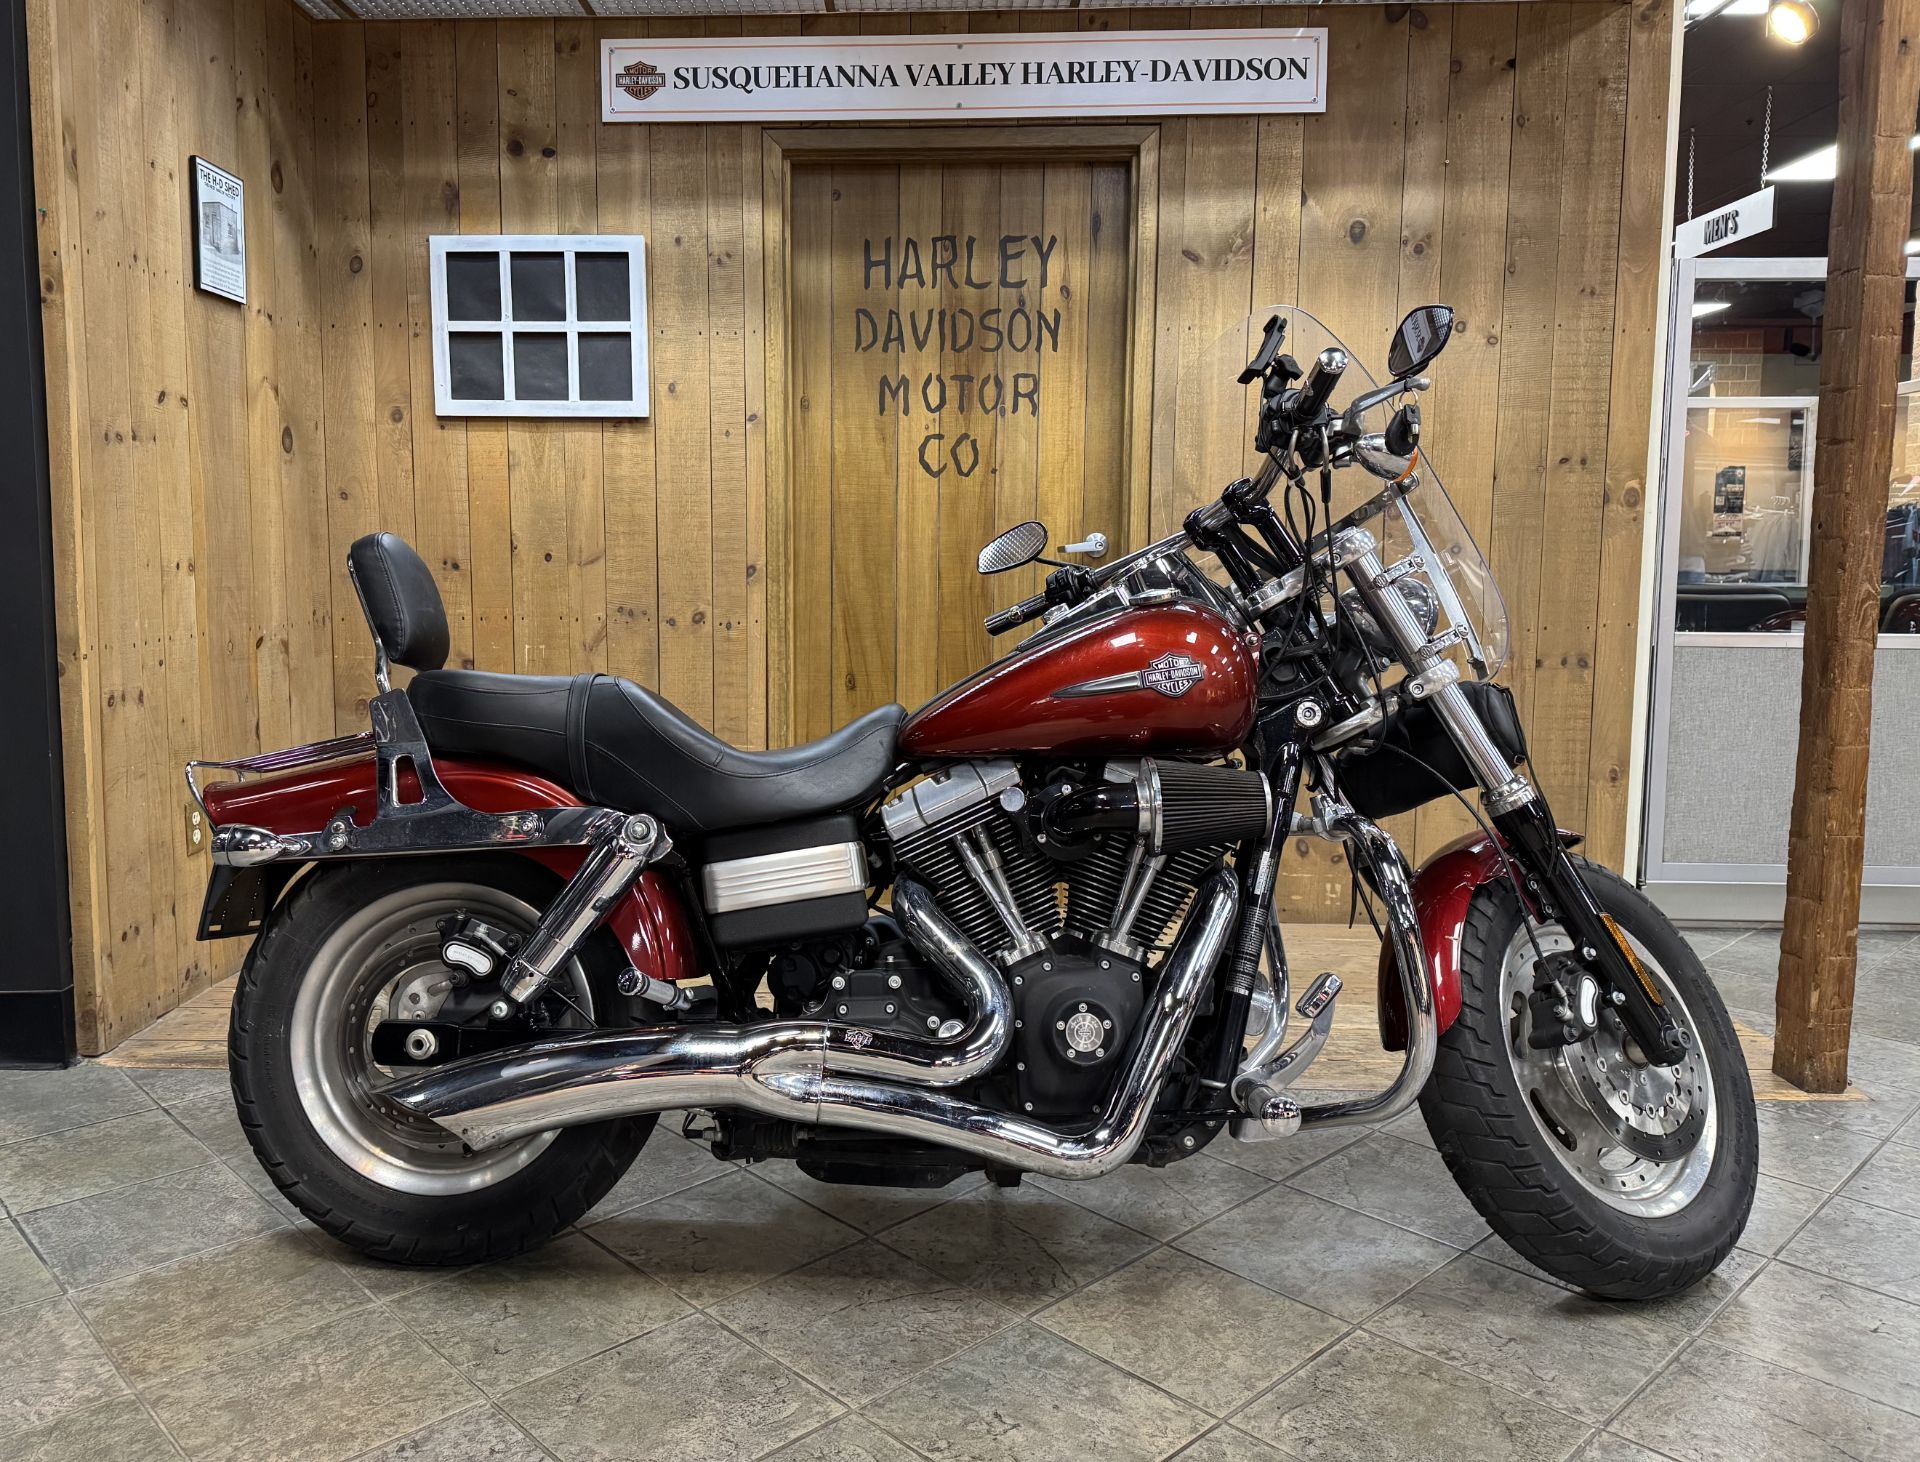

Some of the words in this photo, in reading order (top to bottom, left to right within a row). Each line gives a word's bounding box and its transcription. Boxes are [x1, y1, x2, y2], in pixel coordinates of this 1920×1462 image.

[673, 64, 900, 94] SUSQUEHANNA
[904, 62, 1016, 87] VALLEY
[1020, 57, 1310, 85] HARLEY-DAVIDSON
[200, 168, 211, 183] THE
[224, 181, 239, 197] SHED
[1704, 210, 1739, 245] MEN'S
[864, 235, 1057, 289] HARLEY
[854, 308, 1061, 353] DAVIDSON
[879, 372, 1038, 417] MOTOR
[1147, 667, 1198, 682] HARLEY-DAVIDSON
[1162, 680, 1188, 692] CYCLES
